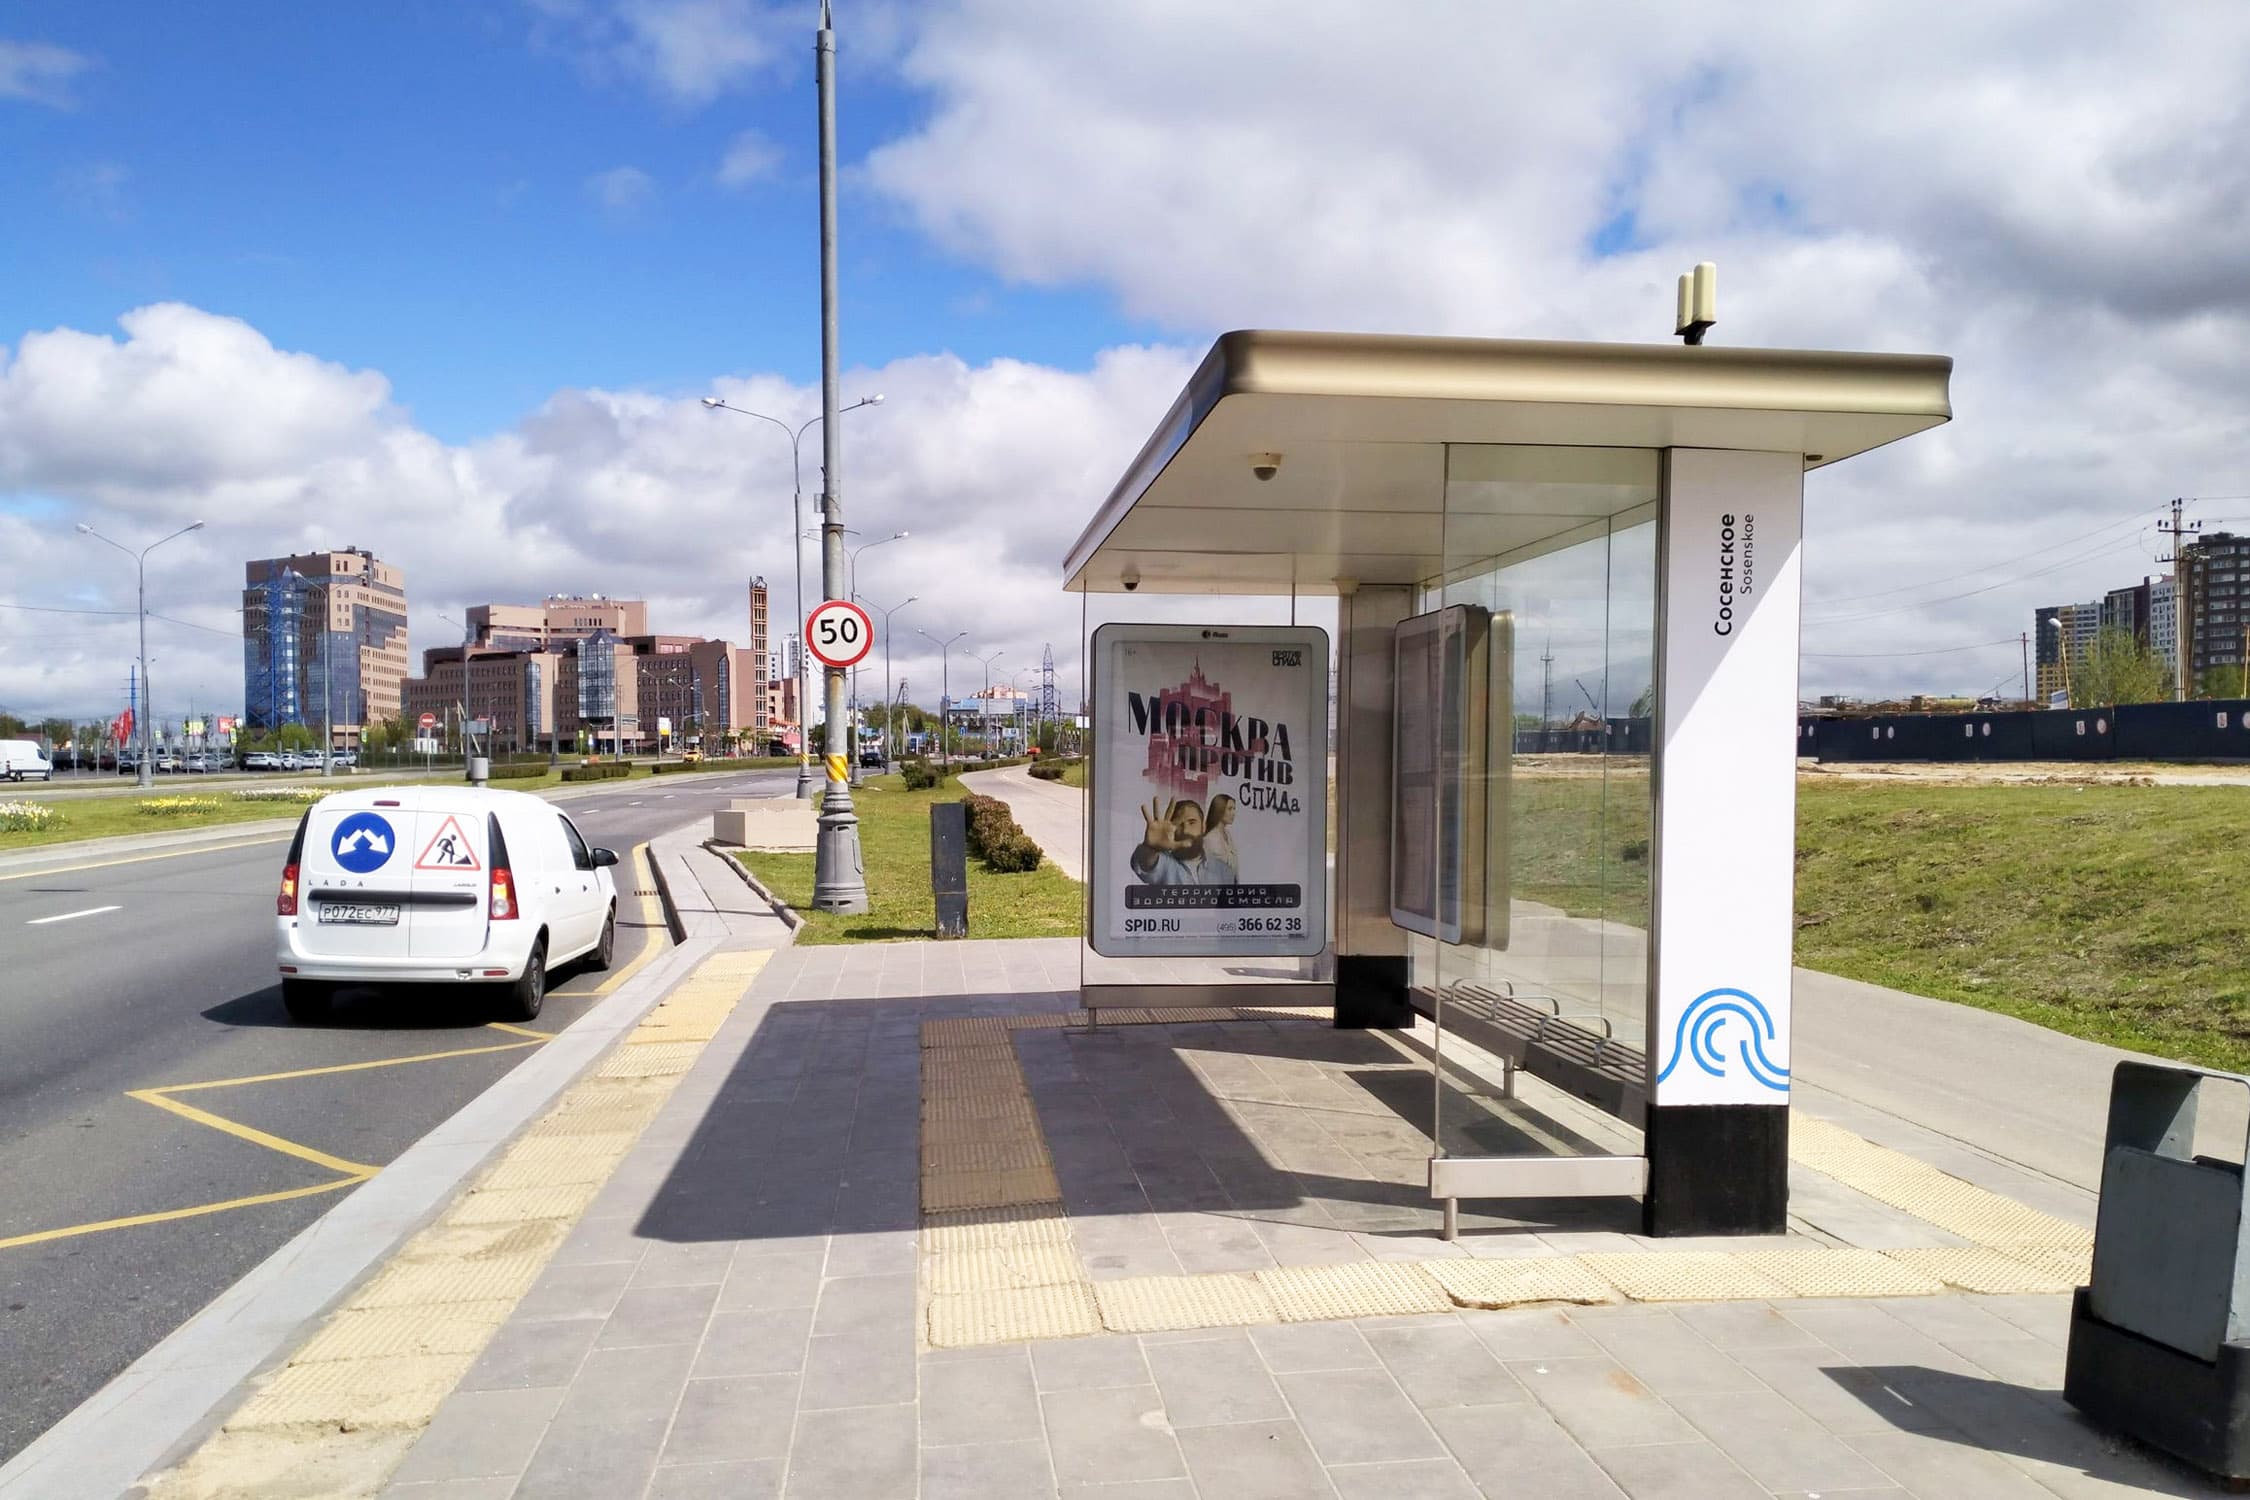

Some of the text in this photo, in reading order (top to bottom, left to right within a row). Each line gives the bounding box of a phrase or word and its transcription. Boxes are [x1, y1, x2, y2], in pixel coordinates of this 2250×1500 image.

[1740, 514, 1754, 594] Sosenskoe
[1714, 513, 1735, 636] Сосенское
[820, 617, 858, 645] 50
[1128, 691, 1292, 761] МОСКВА
[1177, 743, 1294, 785] ПРОТИВ
[308, 879, 364, 888] LADA
[1161, 887, 1268, 898] ТЕРРИТОРИЯ
[1133, 896, 1295, 906] ЗДРАВОГО СМЫСЛА
[1124, 918, 1181, 932] SPID.RU
[1238, 918, 1263, 931] 366
[1266, 918, 1282, 931] 62
[1285, 917, 1302, 931] 38
